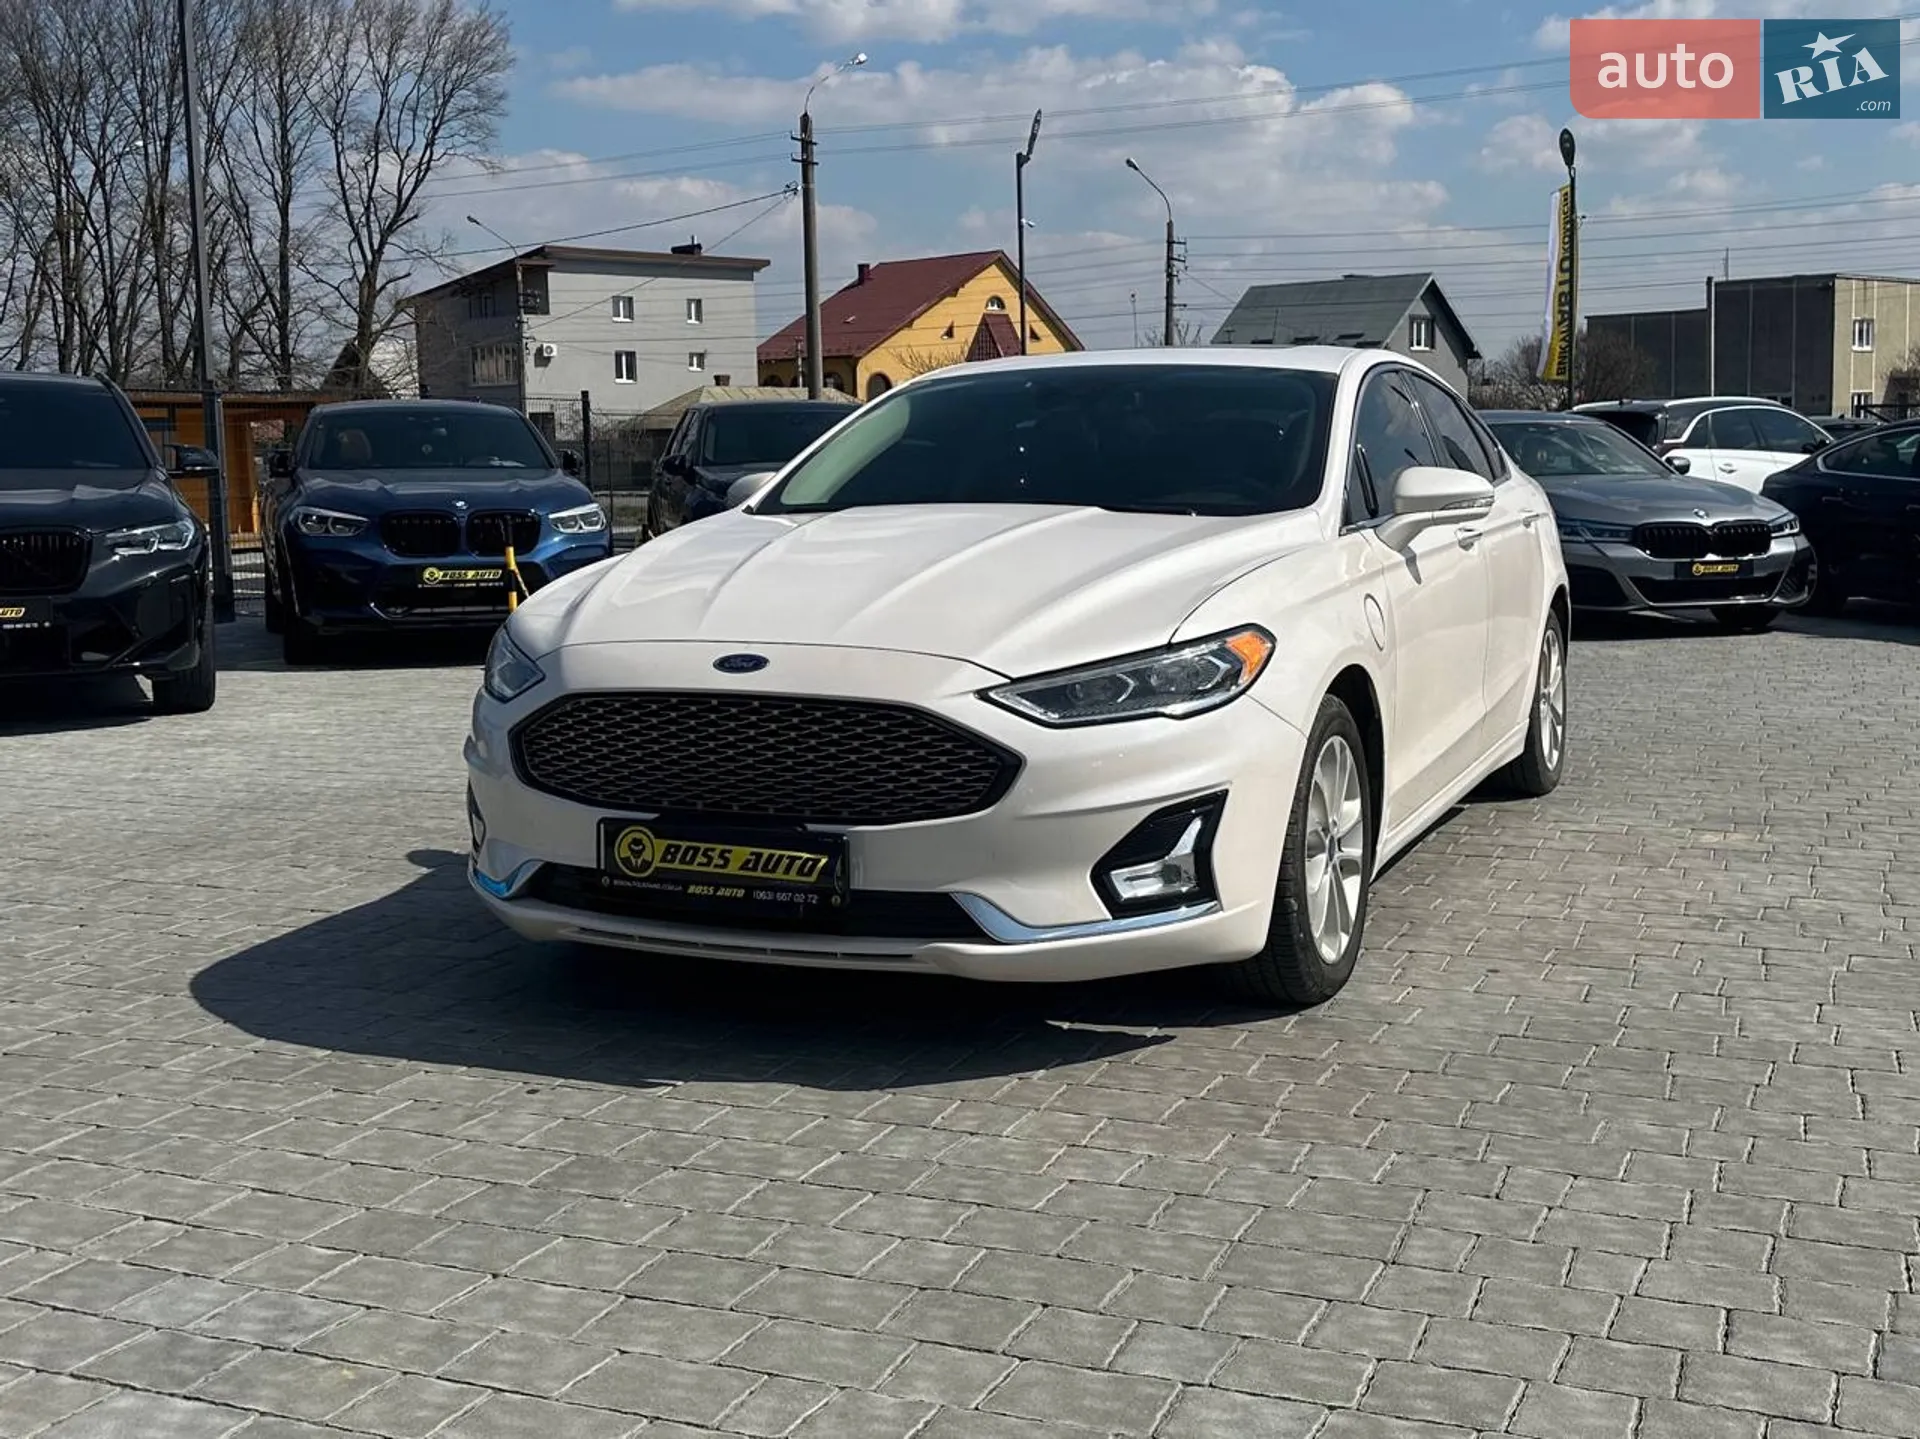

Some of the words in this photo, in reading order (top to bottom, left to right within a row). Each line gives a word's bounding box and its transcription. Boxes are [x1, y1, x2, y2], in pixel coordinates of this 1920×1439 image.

[659, 842, 733, 869] BOSS
[739, 851, 820, 877] AUTO
[687, 884, 714, 895] BOSS
[716, 886, 745, 898] AUTO
